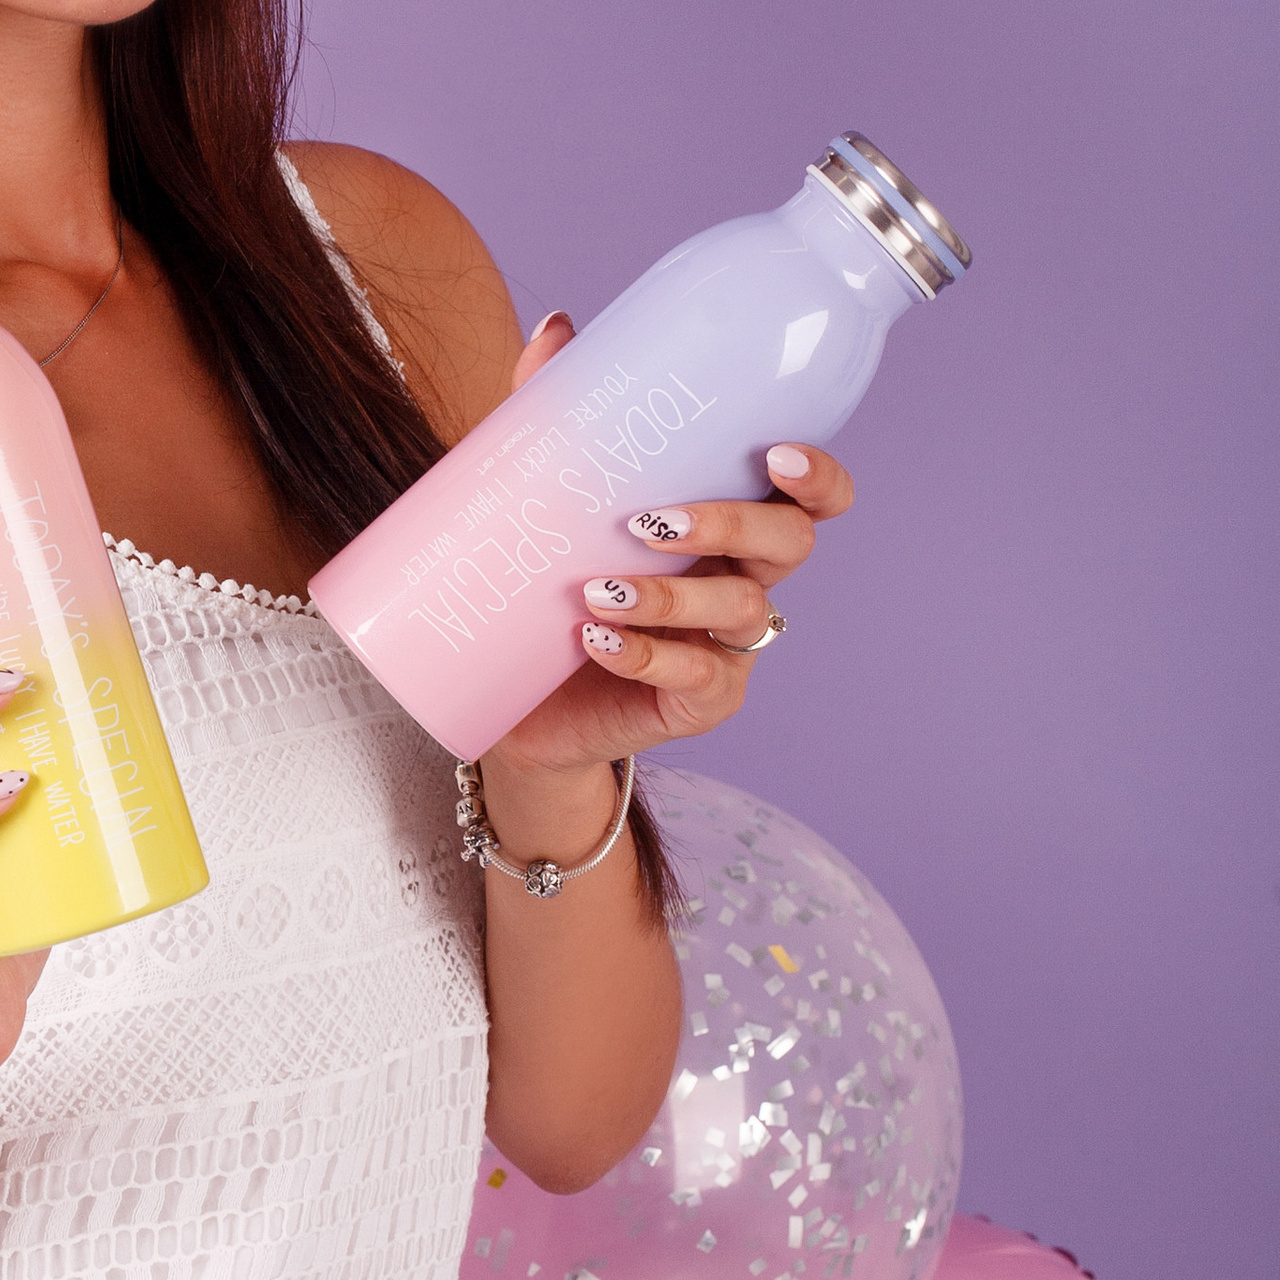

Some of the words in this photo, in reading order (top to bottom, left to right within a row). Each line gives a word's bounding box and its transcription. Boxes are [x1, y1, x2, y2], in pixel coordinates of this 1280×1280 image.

[564, 363, 639, 430] YOU'RE
[476, 456, 495, 476] art
[559, 372, 718, 514] TODAY'S
[454, 487, 504, 532] HAVE
[494, 477, 514, 498] I
[400, 531, 459, 586] WATER
[407, 498, 572, 653] SPECIAL
[15, 708, 45, 721] I
[18, 721, 58, 775] HAVE
[53, 676, 158, 862] SPECIAL
[44, 780, 86, 848] WATER
